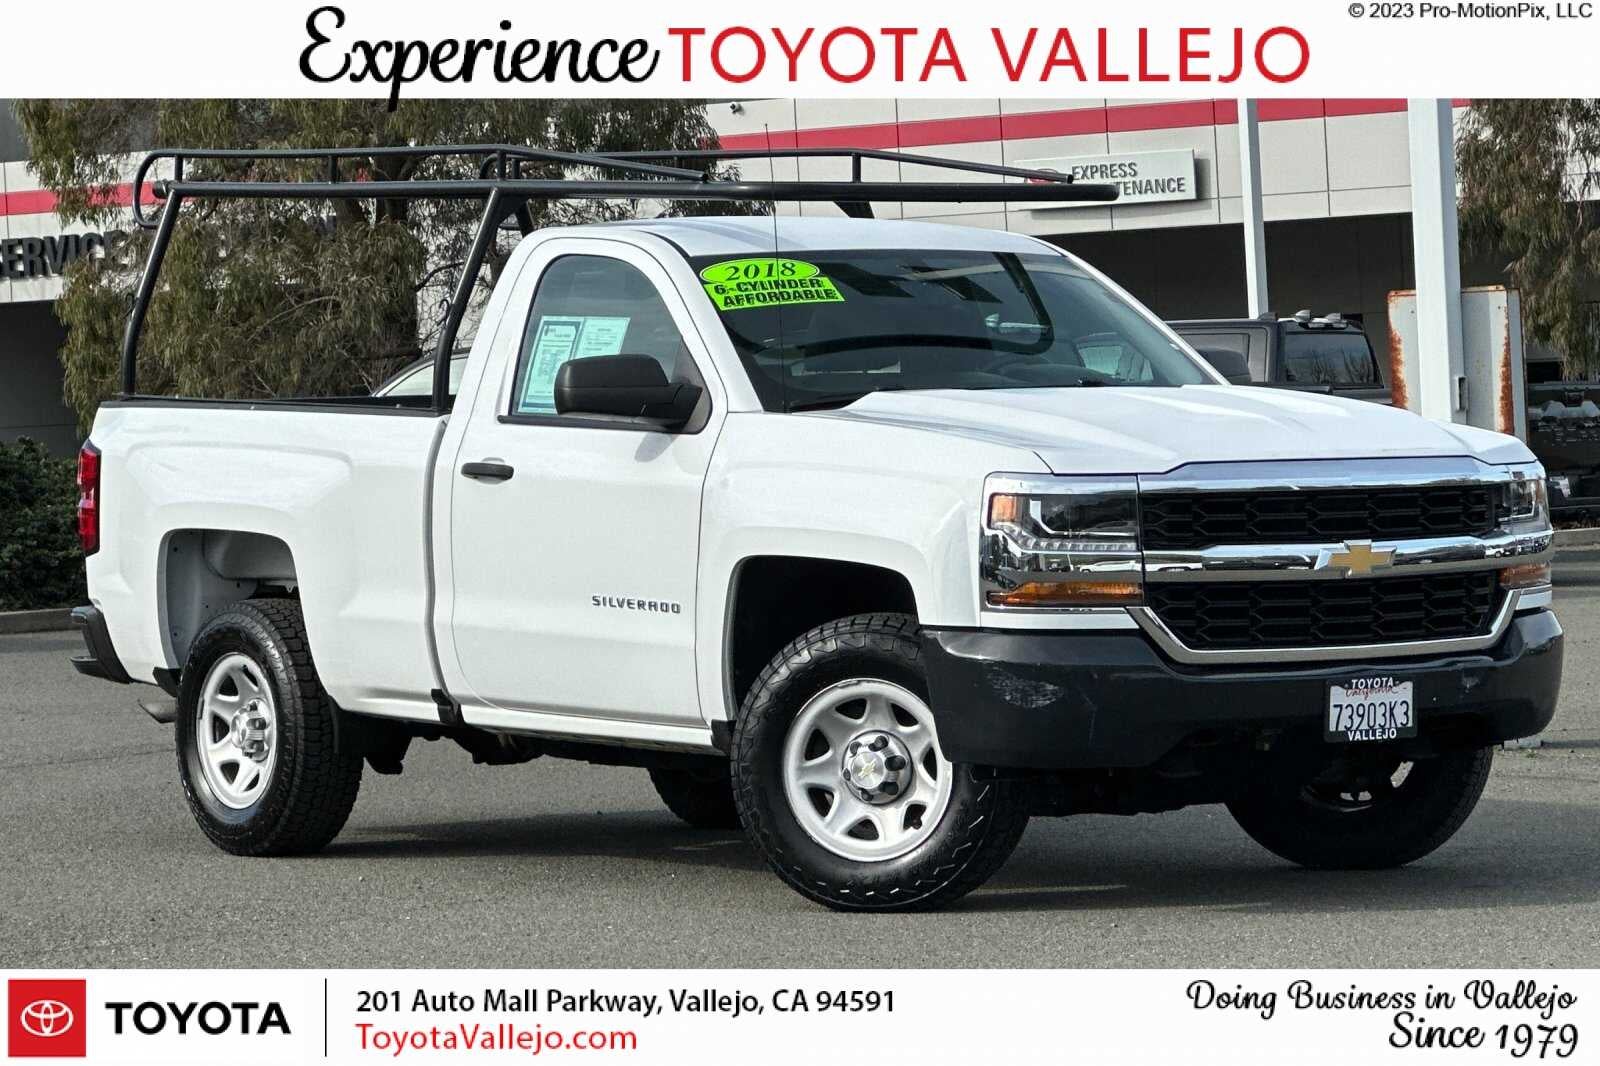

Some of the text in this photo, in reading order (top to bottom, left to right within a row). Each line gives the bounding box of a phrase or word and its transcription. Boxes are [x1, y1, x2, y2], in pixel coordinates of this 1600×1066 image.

[1071, 162, 1139, 181] EXPRESS
[1112, 176, 1187, 197] TENANCE
[724, 261, 797, 282] 2018
[722, 288, 838, 307] AFFORDABLE
[591, 595, 681, 614] SILVERADO
[1351, 676, 1394, 690] TOYOTA
[1332, 700, 1410, 731] 73903K3
[1347, 728, 1397, 742] VALLEJO
